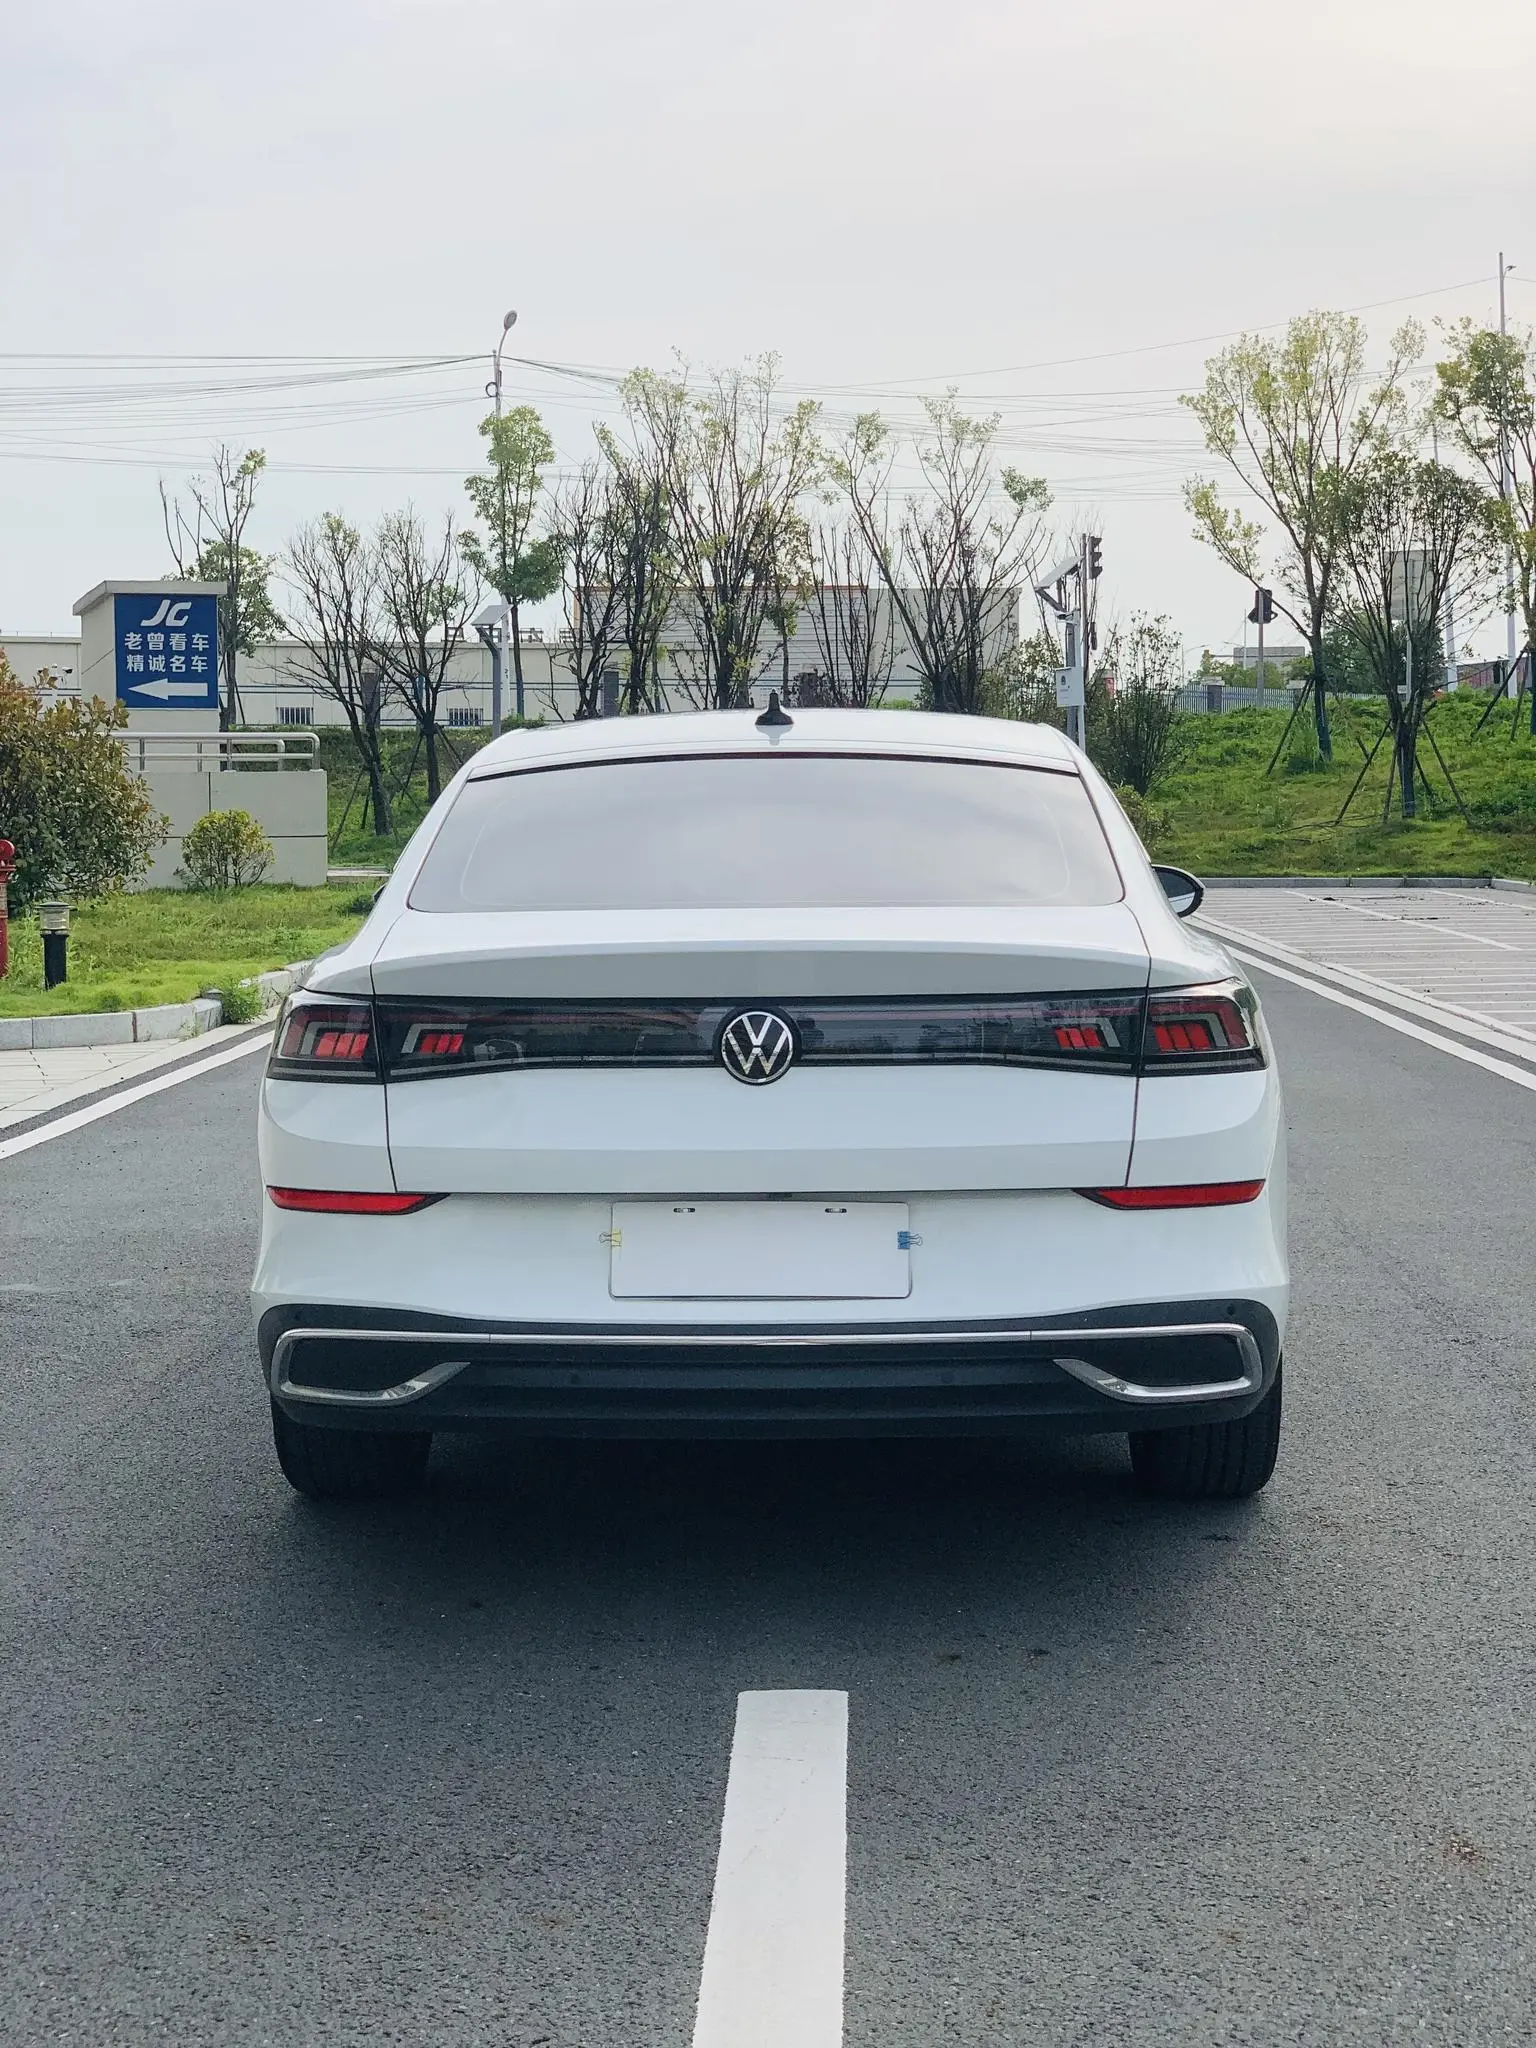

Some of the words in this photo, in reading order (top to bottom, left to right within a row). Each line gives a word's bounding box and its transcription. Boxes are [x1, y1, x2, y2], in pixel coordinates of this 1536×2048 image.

[124, 632, 210, 651] 老曾看车
[126, 654, 208, 673] 精诚名车
[724, 1013, 790, 1077] VW
